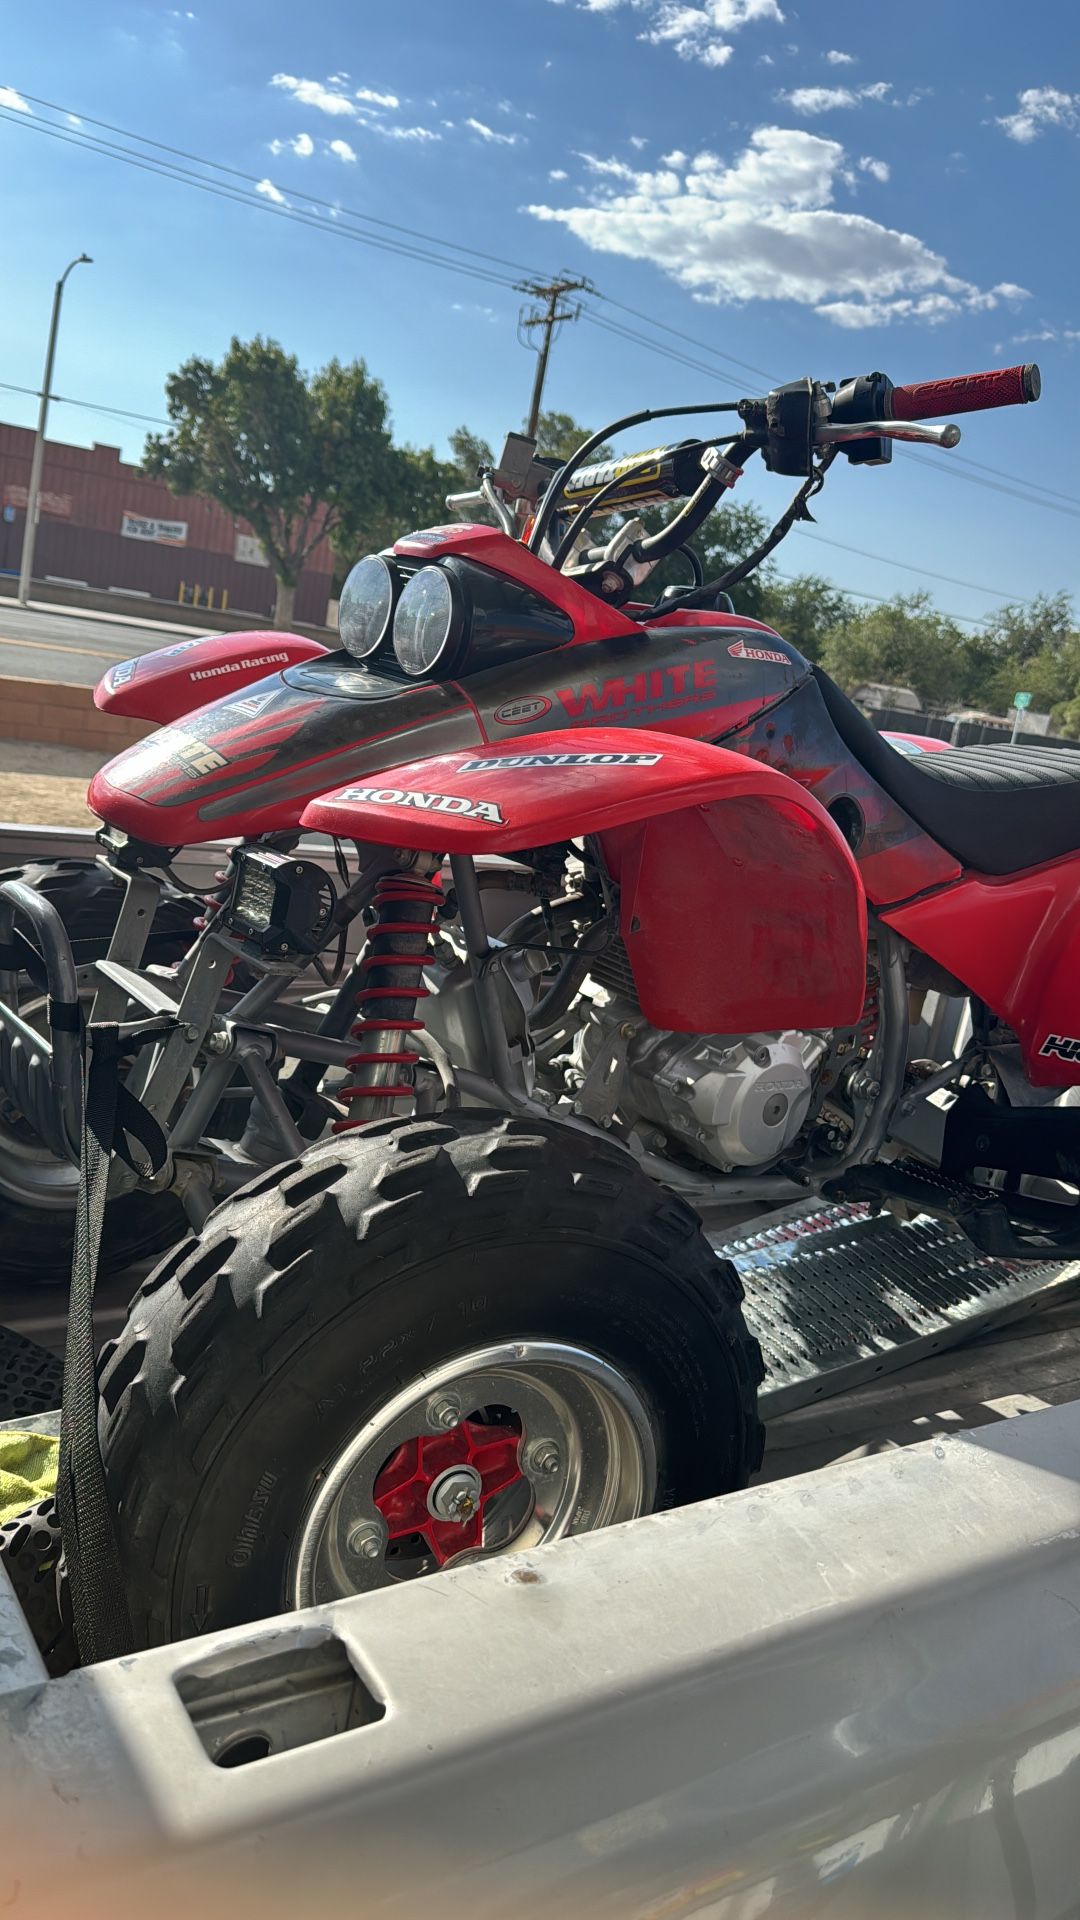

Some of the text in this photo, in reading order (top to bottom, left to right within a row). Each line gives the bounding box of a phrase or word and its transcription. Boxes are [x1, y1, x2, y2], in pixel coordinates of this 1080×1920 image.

[189, 651, 290, 682] Honda Racing
[745, 648, 791, 664] HONDA
[555, 658, 718, 718] WHITE
[501, 701, 541, 718] CEET
[466, 754, 657, 771] DUNLOP
[334, 788, 504, 824] HONDA
